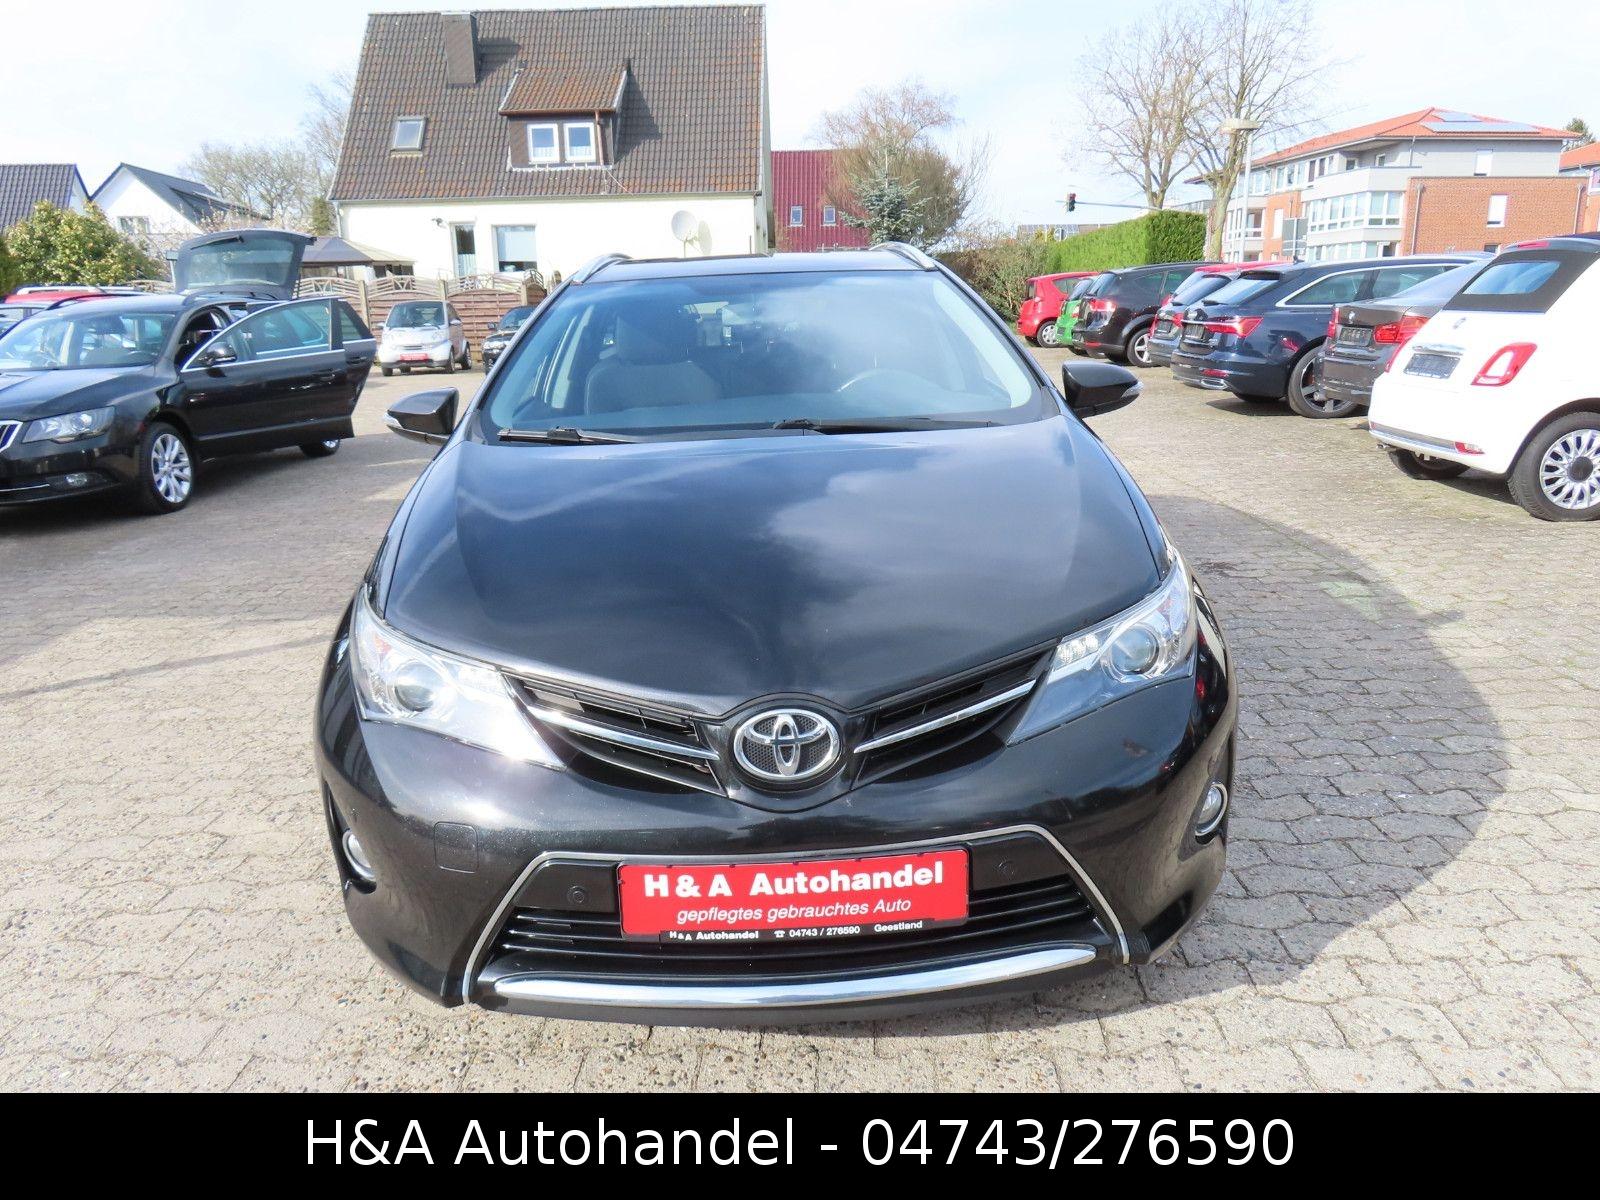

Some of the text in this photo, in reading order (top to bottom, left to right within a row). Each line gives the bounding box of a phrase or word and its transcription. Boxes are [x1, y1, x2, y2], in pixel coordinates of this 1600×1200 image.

[749, 860, 943, 896] Autohandel
[677, 898, 912, 925] gepflegtes gebrauchtes Auto
[696, 930, 759, 940] Autohandel
[789, 927, 818, 938] 04743
[874, 920, 923, 933] Geestland
